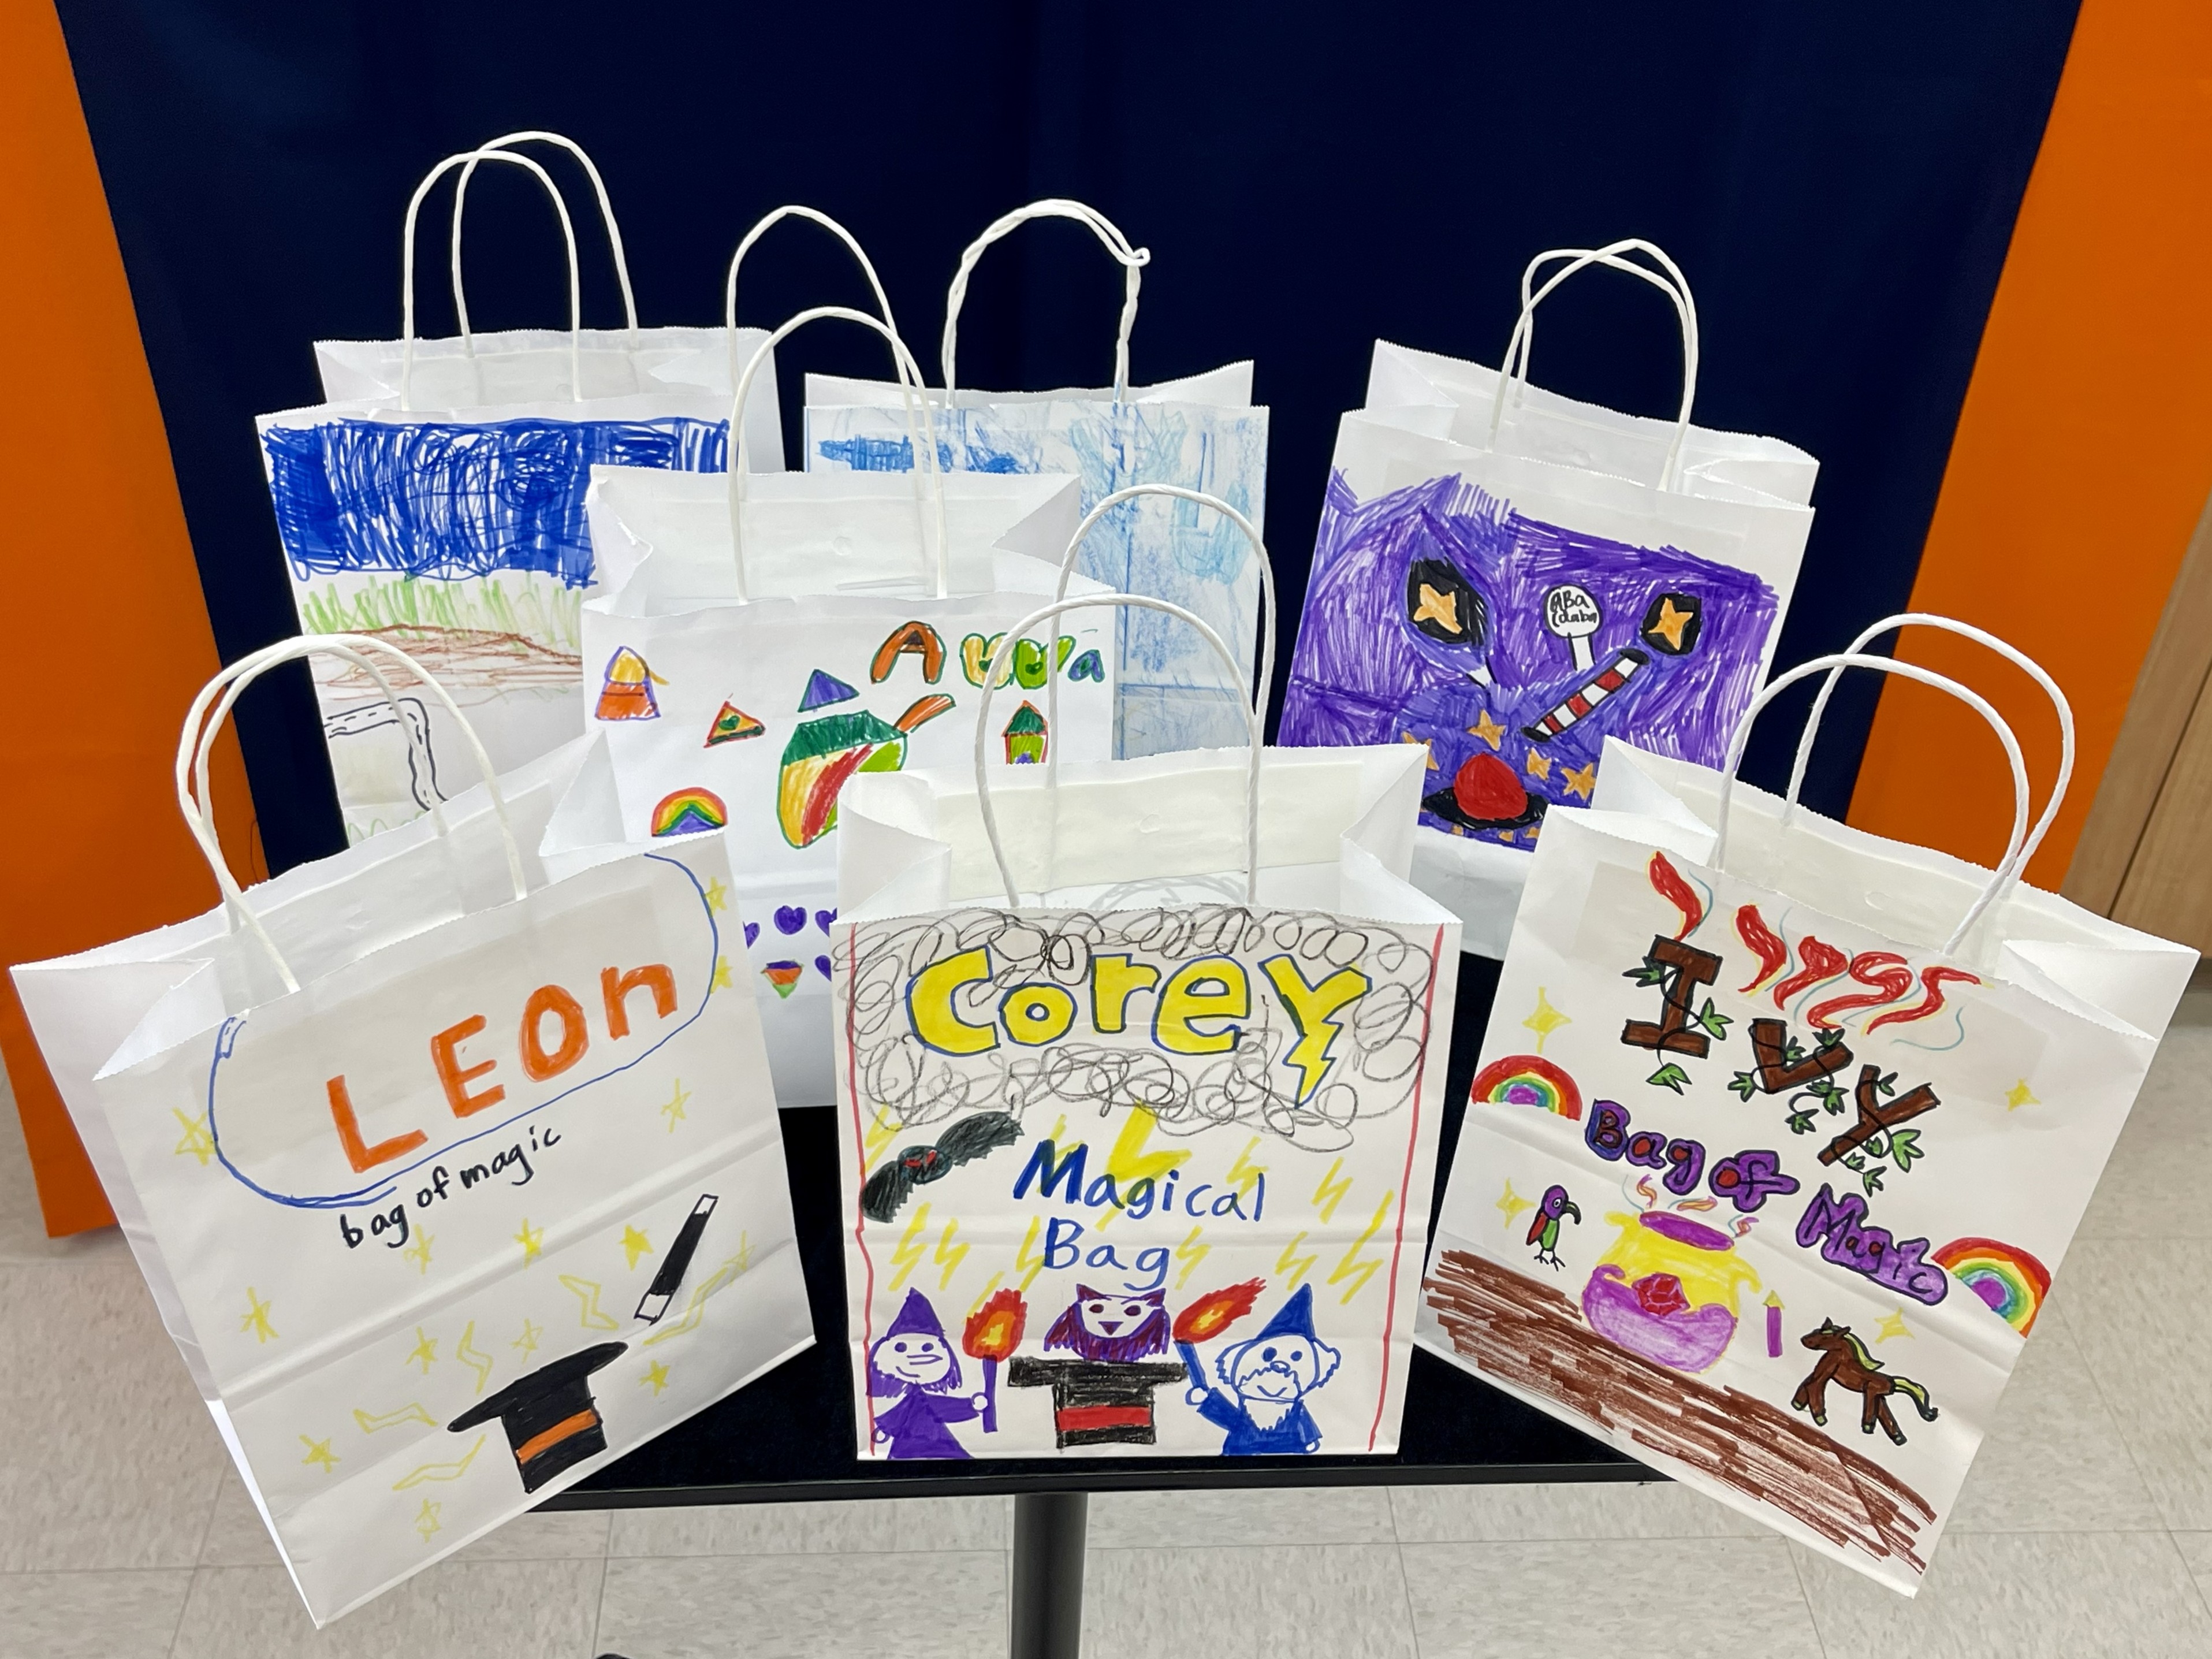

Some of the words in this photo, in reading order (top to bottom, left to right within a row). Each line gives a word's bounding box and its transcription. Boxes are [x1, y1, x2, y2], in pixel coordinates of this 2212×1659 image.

[1620, 934, 1942, 1167] IVY
[340, 1204, 409, 1248] bag
[416, 1166, 450, 1207] of
[459, 1125, 561, 1189] magic
[1012, 1138, 1265, 1222] Magical
[1585, 1099, 1706, 1196] Bag
[1708, 1150, 1801, 1212] of
[1796, 1182, 1948, 1306] Magic
[1044, 1217, 1170, 1291] Bag
